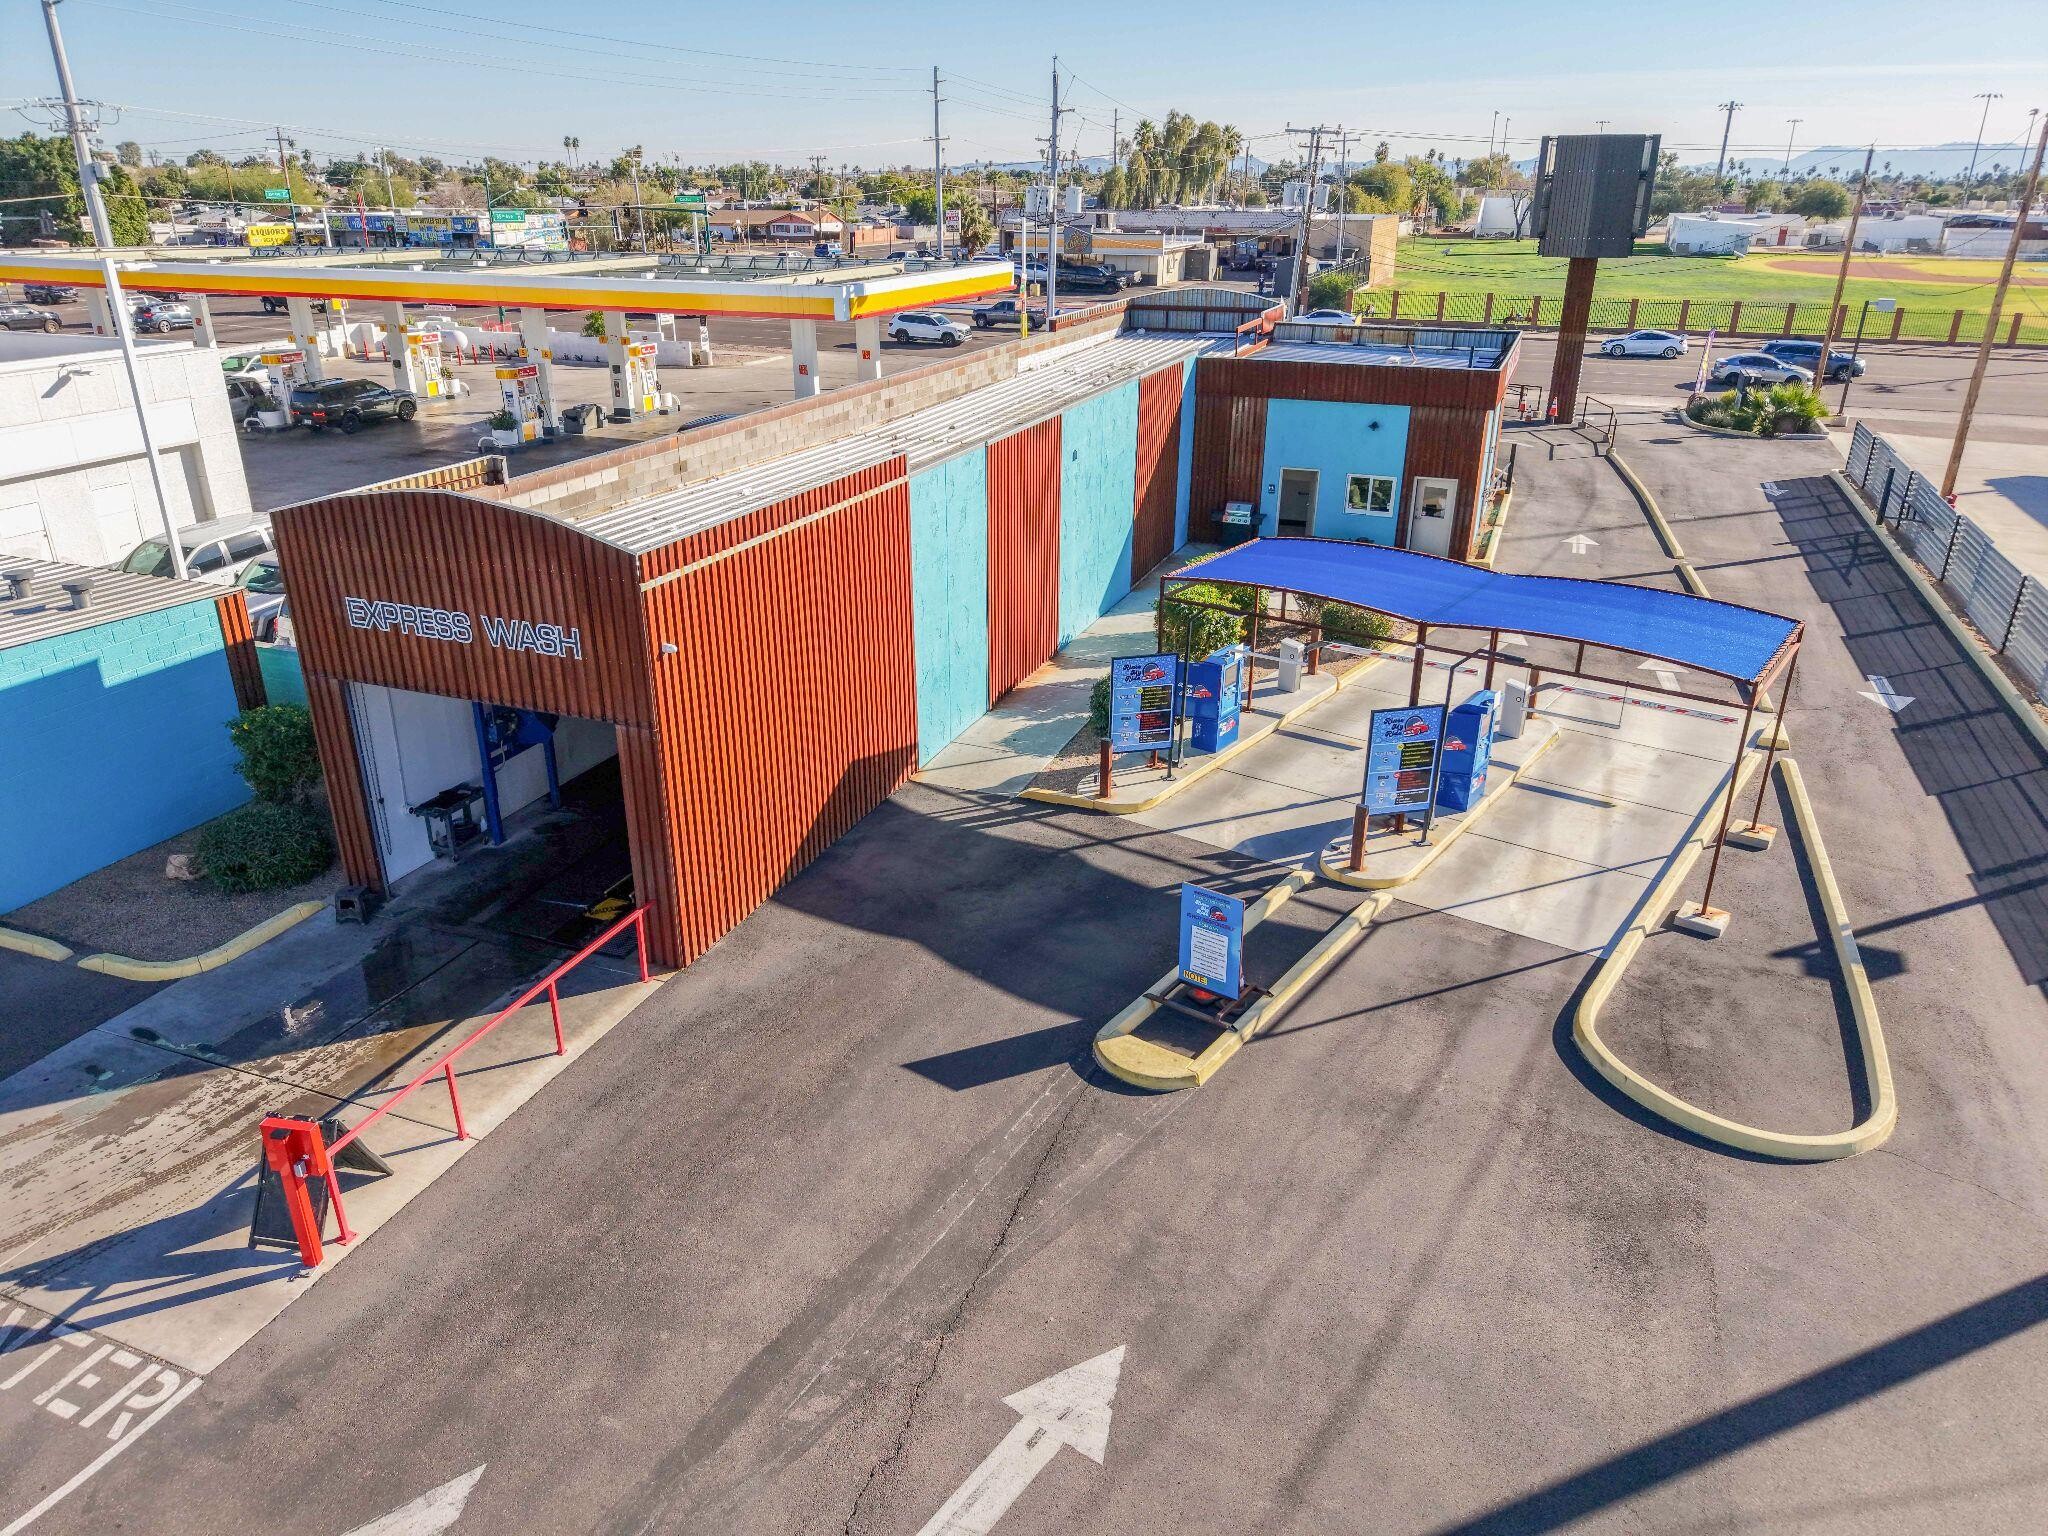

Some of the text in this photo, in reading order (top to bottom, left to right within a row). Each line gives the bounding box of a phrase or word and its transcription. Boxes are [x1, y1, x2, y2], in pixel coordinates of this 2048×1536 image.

[250, 228, 286, 237] LIQUORS
[345, 596, 582, 660] EXPRESS WASH
[0, 1302, 181, 1440] NTER
